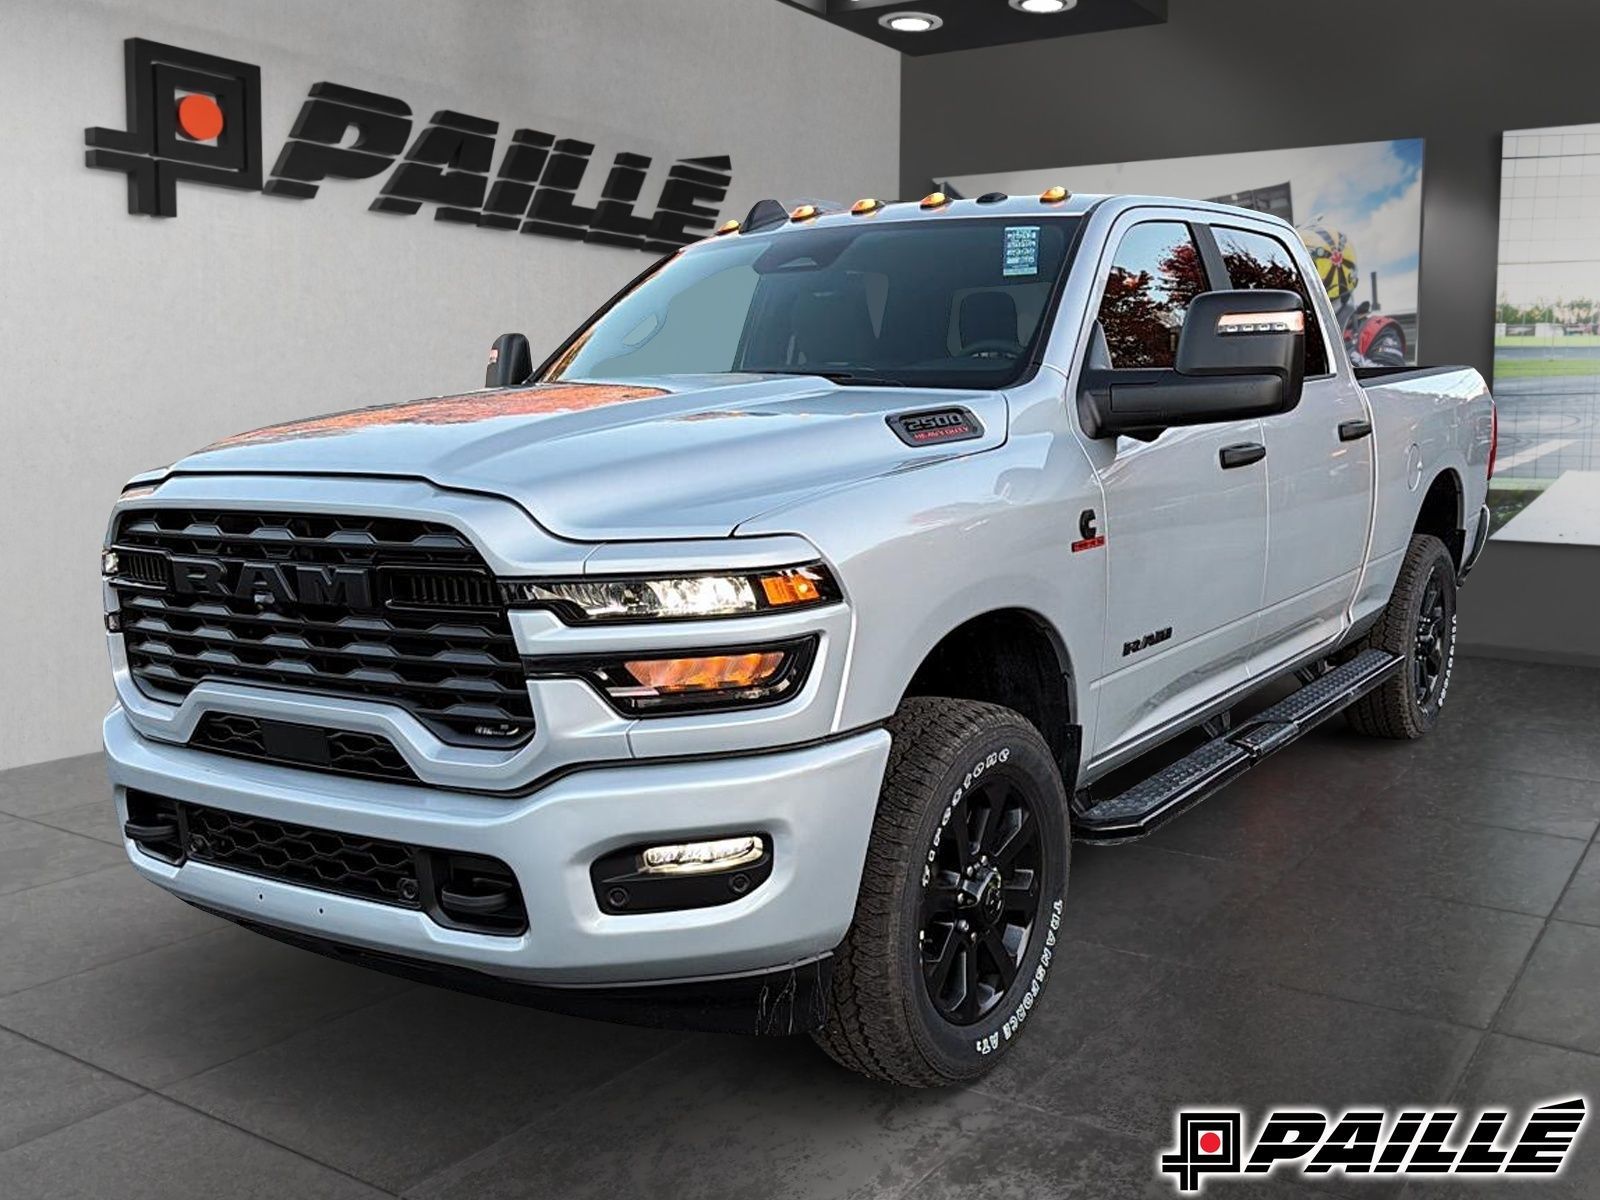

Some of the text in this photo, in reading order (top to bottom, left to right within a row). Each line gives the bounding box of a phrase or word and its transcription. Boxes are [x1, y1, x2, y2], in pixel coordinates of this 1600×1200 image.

[262, 81, 733, 253] PAILLÉ
[908, 413, 962, 430] 2500
[171, 555, 374, 609] RAM
[1122, 626, 1173, 657] RAM
